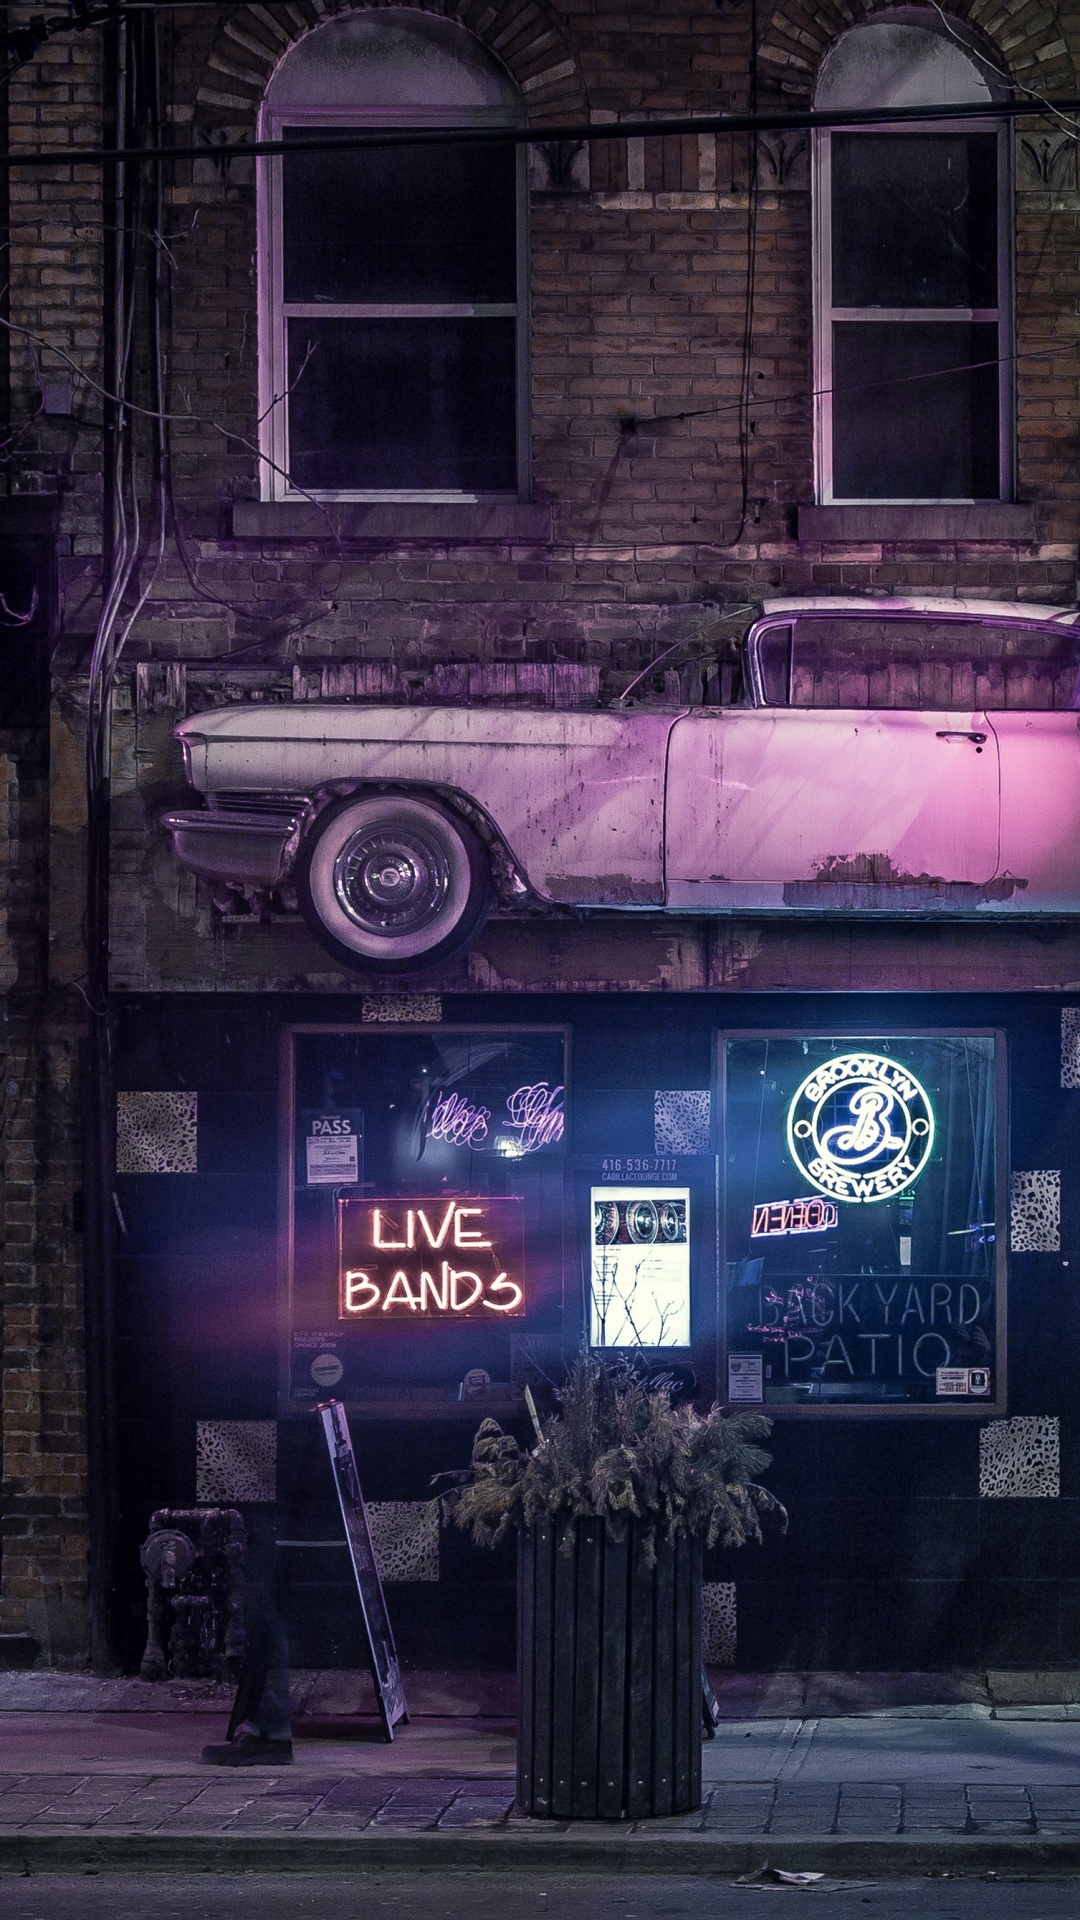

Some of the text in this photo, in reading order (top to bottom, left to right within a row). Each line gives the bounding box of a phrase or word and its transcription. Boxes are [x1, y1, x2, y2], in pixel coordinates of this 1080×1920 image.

[804, 1059, 918, 1102] BROOKLYN
[312, 1120, 351, 1135] PASS
[601, 1159, 677, 1171] 416-536-7717
[601, 1172, 678, 1181] CADILLACLOUNGE.COM
[808, 1155, 915, 1197] BREWERY
[372, 1201, 492, 1249] LIVE
[344, 1260, 524, 1311] BANDS
[784, 1332, 949, 1377] PATIO
